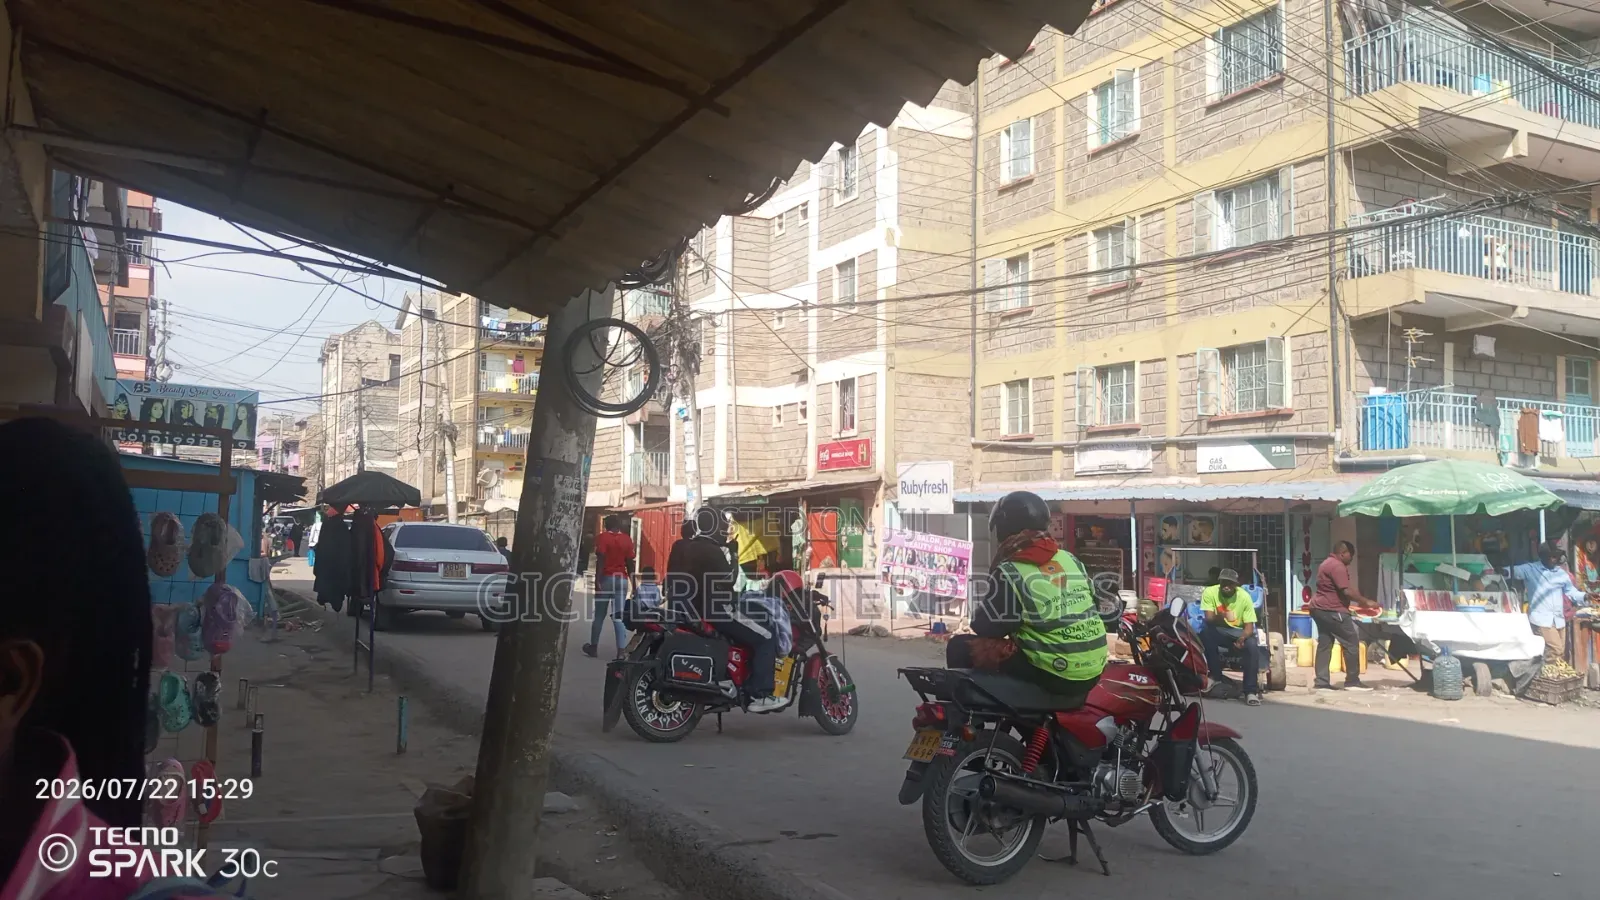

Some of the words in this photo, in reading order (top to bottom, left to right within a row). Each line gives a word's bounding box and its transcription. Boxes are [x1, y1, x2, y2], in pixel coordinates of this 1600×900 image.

[156, 385, 186, 398] Beauty
[188, 387, 209, 398] Spot
[211, 389, 237, 398] Salon
[127, 433, 247, 450] 010199889
[900, 479, 948, 498] Rubyfresh
[1487, 482, 1527, 494] YOU
[934, 546, 953, 554] SHOP
[943, 539, 956, 548] SPA
[957, 541, 971, 550] AND
[1128, 673, 1148, 684] TVS
[636, 672, 656, 722] SNIPER
